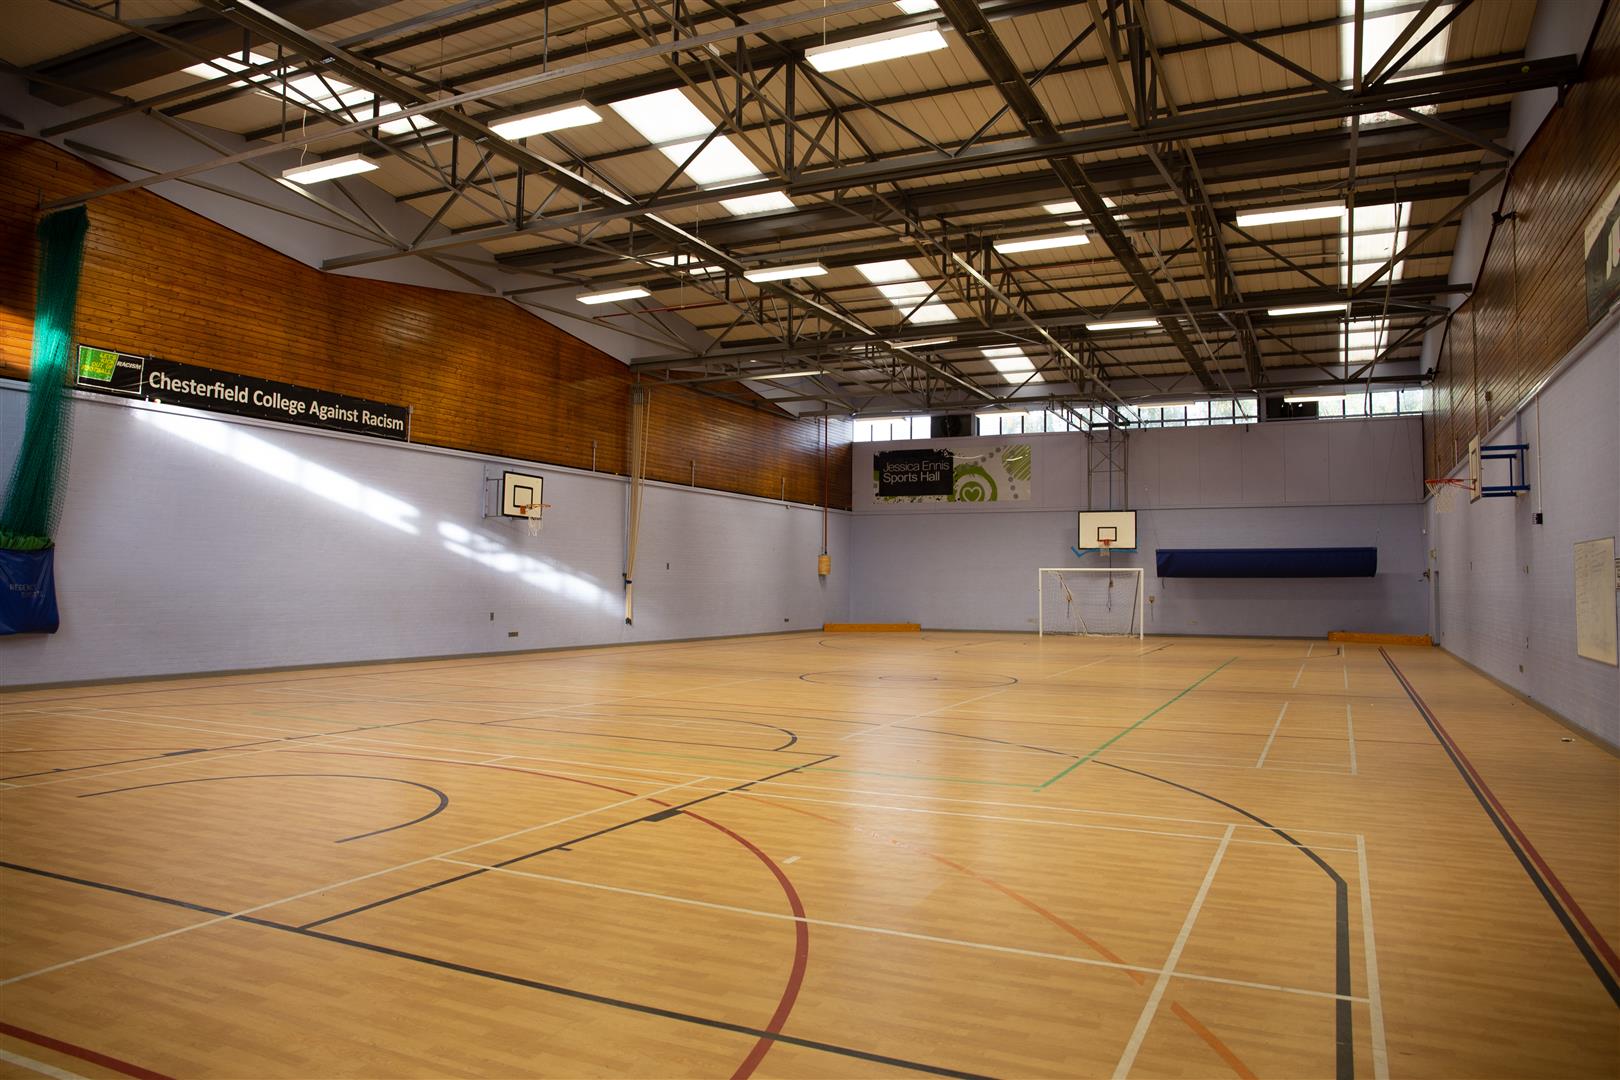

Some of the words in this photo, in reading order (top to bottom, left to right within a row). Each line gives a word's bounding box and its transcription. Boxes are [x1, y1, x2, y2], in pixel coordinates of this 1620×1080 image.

[116, 361, 142, 370] RACISM
[149, 371, 249, 403] Chesterfield
[253, 390, 306, 415] College
[309, 401, 358, 422] Against
[362, 410, 404, 431] Racism
[883, 461, 920, 472] Jessica
[922, 461, 950, 471] Ennis
[883, 472, 918, 485] Sports
[920, 471, 940, 481] Hall
